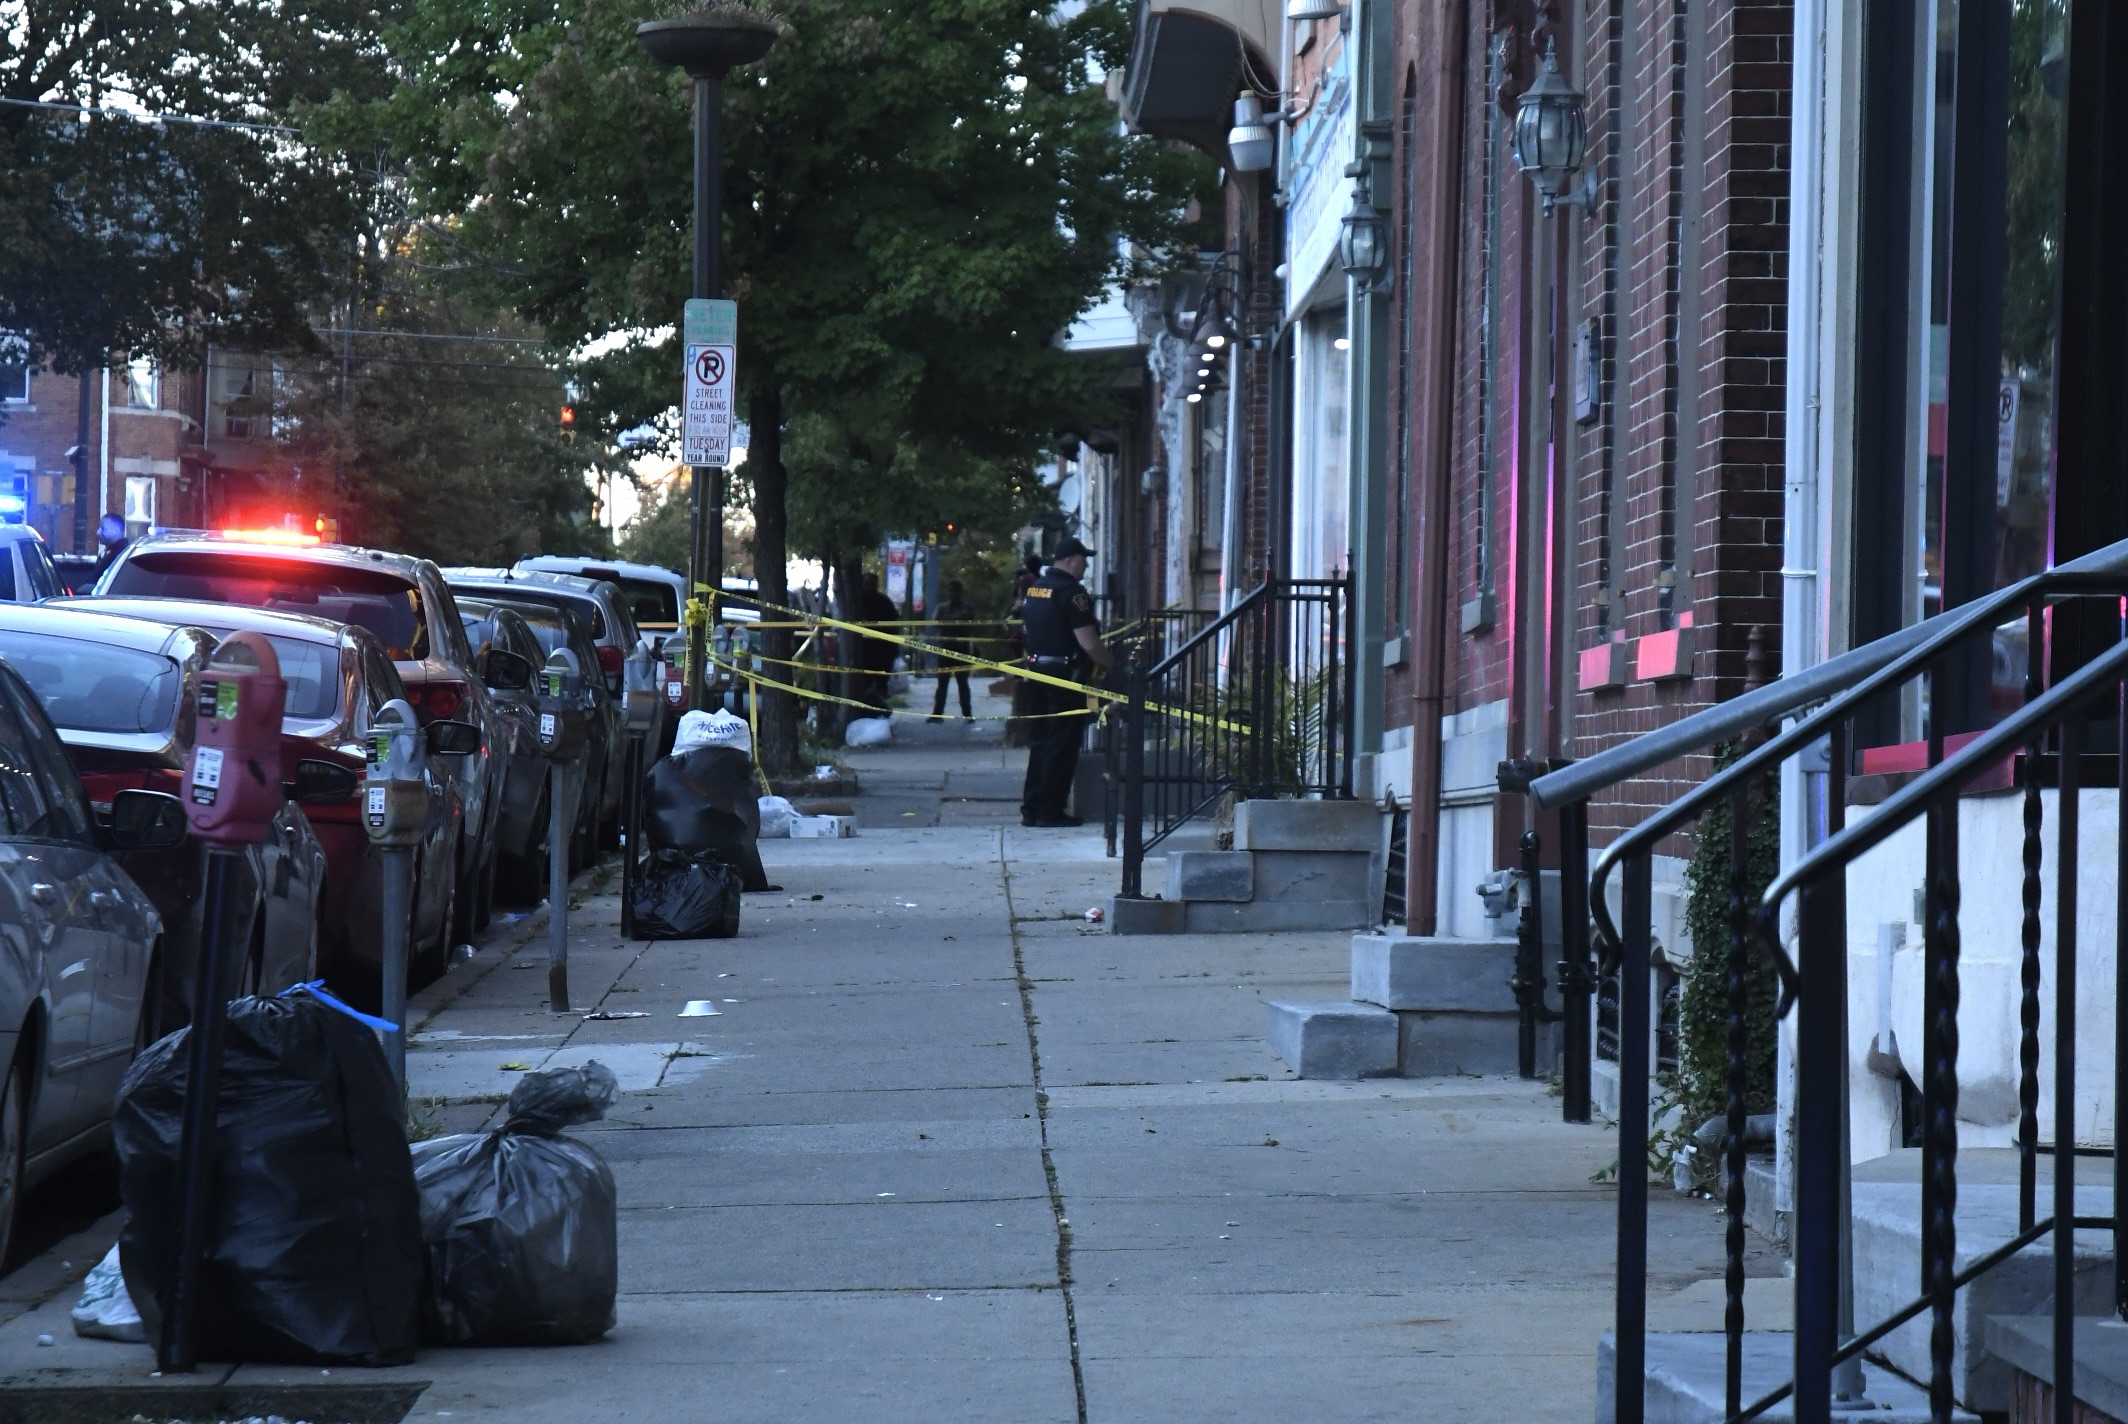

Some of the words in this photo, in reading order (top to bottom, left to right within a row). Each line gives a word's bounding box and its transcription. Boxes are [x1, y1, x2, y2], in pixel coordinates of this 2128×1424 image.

[696, 388, 722, 399] STREET
[690, 400, 727, 411] CLEANING
[690, 413, 706, 424] THIS
[710, 413, 727, 424] SIDE
[689, 437, 725, 450] TUESDAY
[687, 453, 703, 462] YEAR
[704, 453, 725, 463] ROUND
[1027, 587, 1052, 598] POLICE
